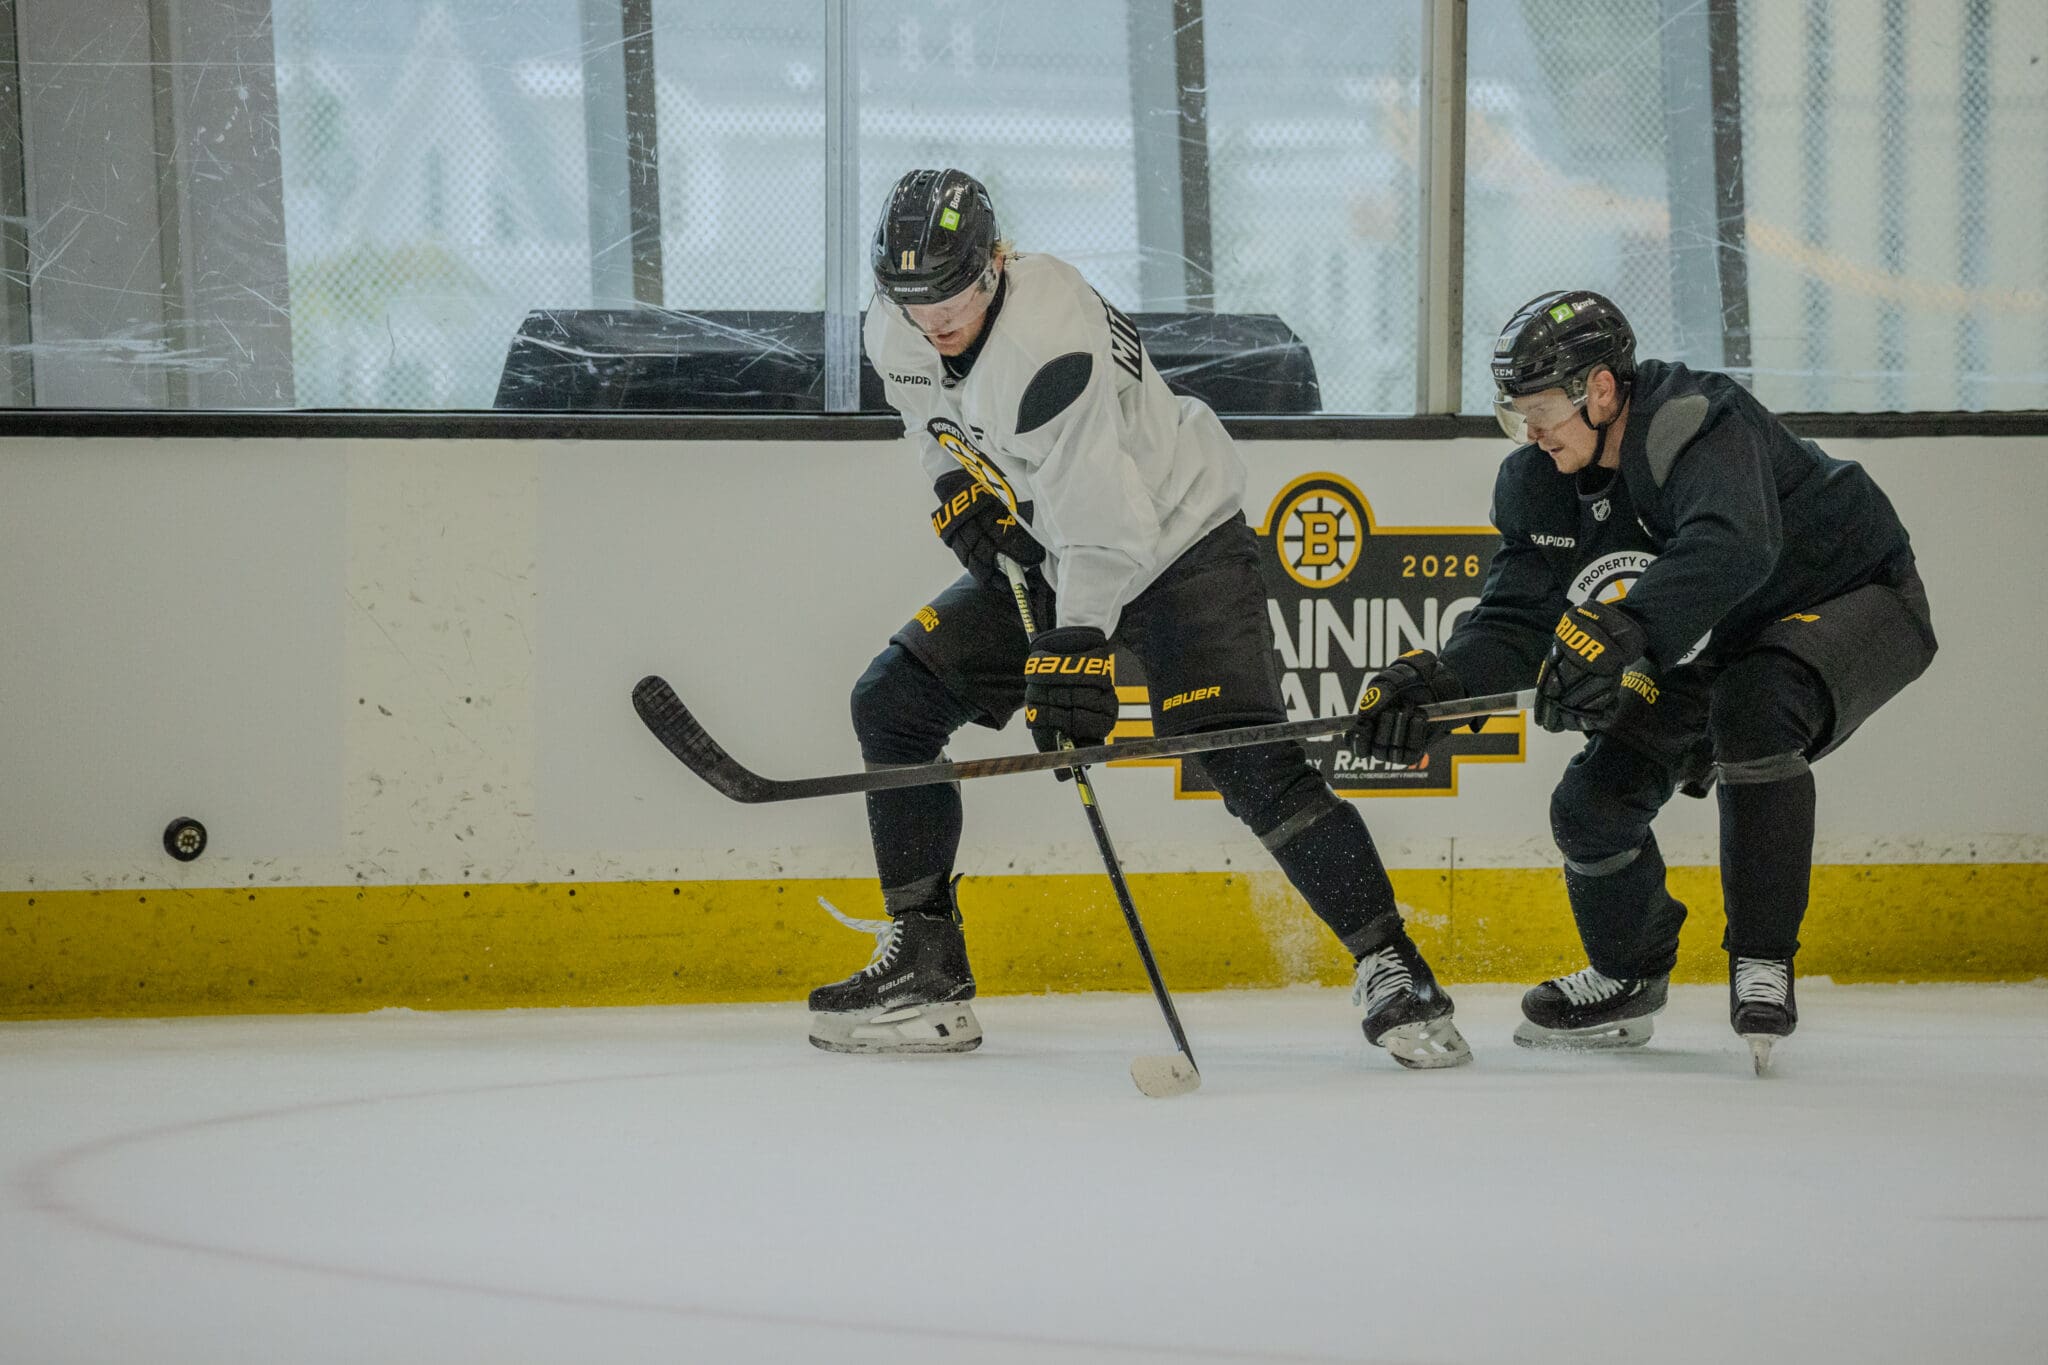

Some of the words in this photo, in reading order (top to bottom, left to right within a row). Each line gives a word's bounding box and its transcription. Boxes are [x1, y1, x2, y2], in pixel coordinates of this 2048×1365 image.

[949, 184, 966, 209] Bank
[901, 250, 915, 270] 11
[1571, 298, 1597, 311] Bank
[1494, 368, 1513, 376] CCM
[1301, 512, 1340, 566] B
[1402, 555, 1479, 577] 2026
[1577, 556, 1637, 592] PROPERTY
[1639, 559, 1650, 568] O
[1555, 613, 1606, 663] RIOR
[1163, 686, 1221, 712] BAUER
[1621, 675, 1660, 705] RUINS
[877, 972, 915, 994] BAUER
